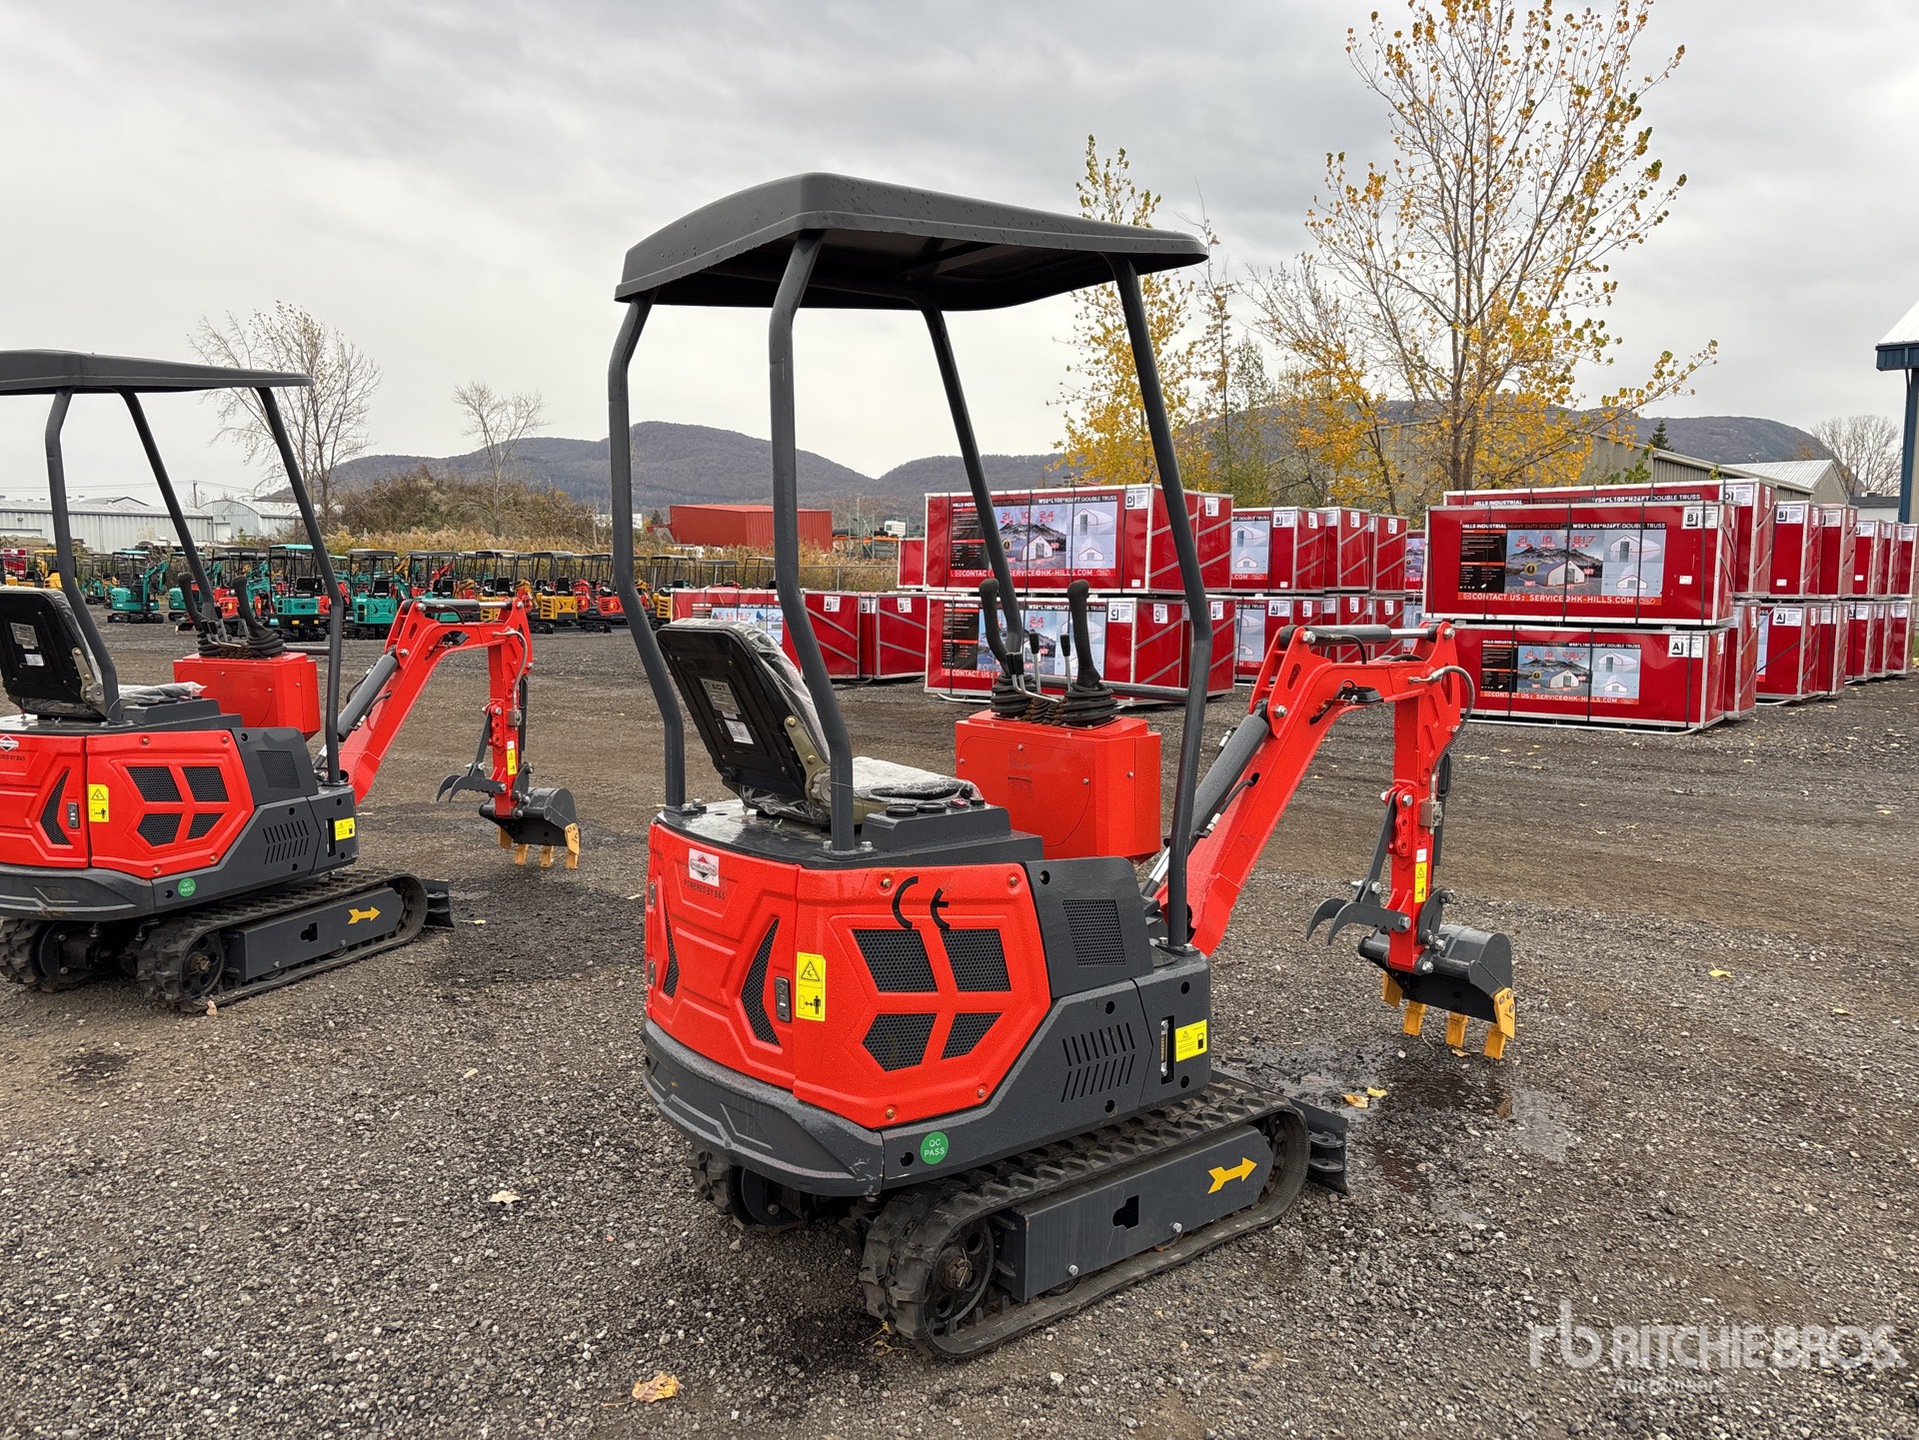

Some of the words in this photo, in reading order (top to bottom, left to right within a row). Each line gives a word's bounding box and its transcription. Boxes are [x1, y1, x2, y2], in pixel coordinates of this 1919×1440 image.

[1127, 496, 1133, 504] D
[1651, 494, 1678, 502] DOUBLE
[1687, 513, 1695, 522] B
[1778, 511, 1785, 519] B
[1472, 592, 1508, 600] CONTACT
[1110, 609, 1117, 617] C
[1672, 642, 1680, 651] A
[951, 669, 979, 678] CONTACT
[928, 1138, 941, 1148] QC
[924, 1147, 945, 1158] PASS
